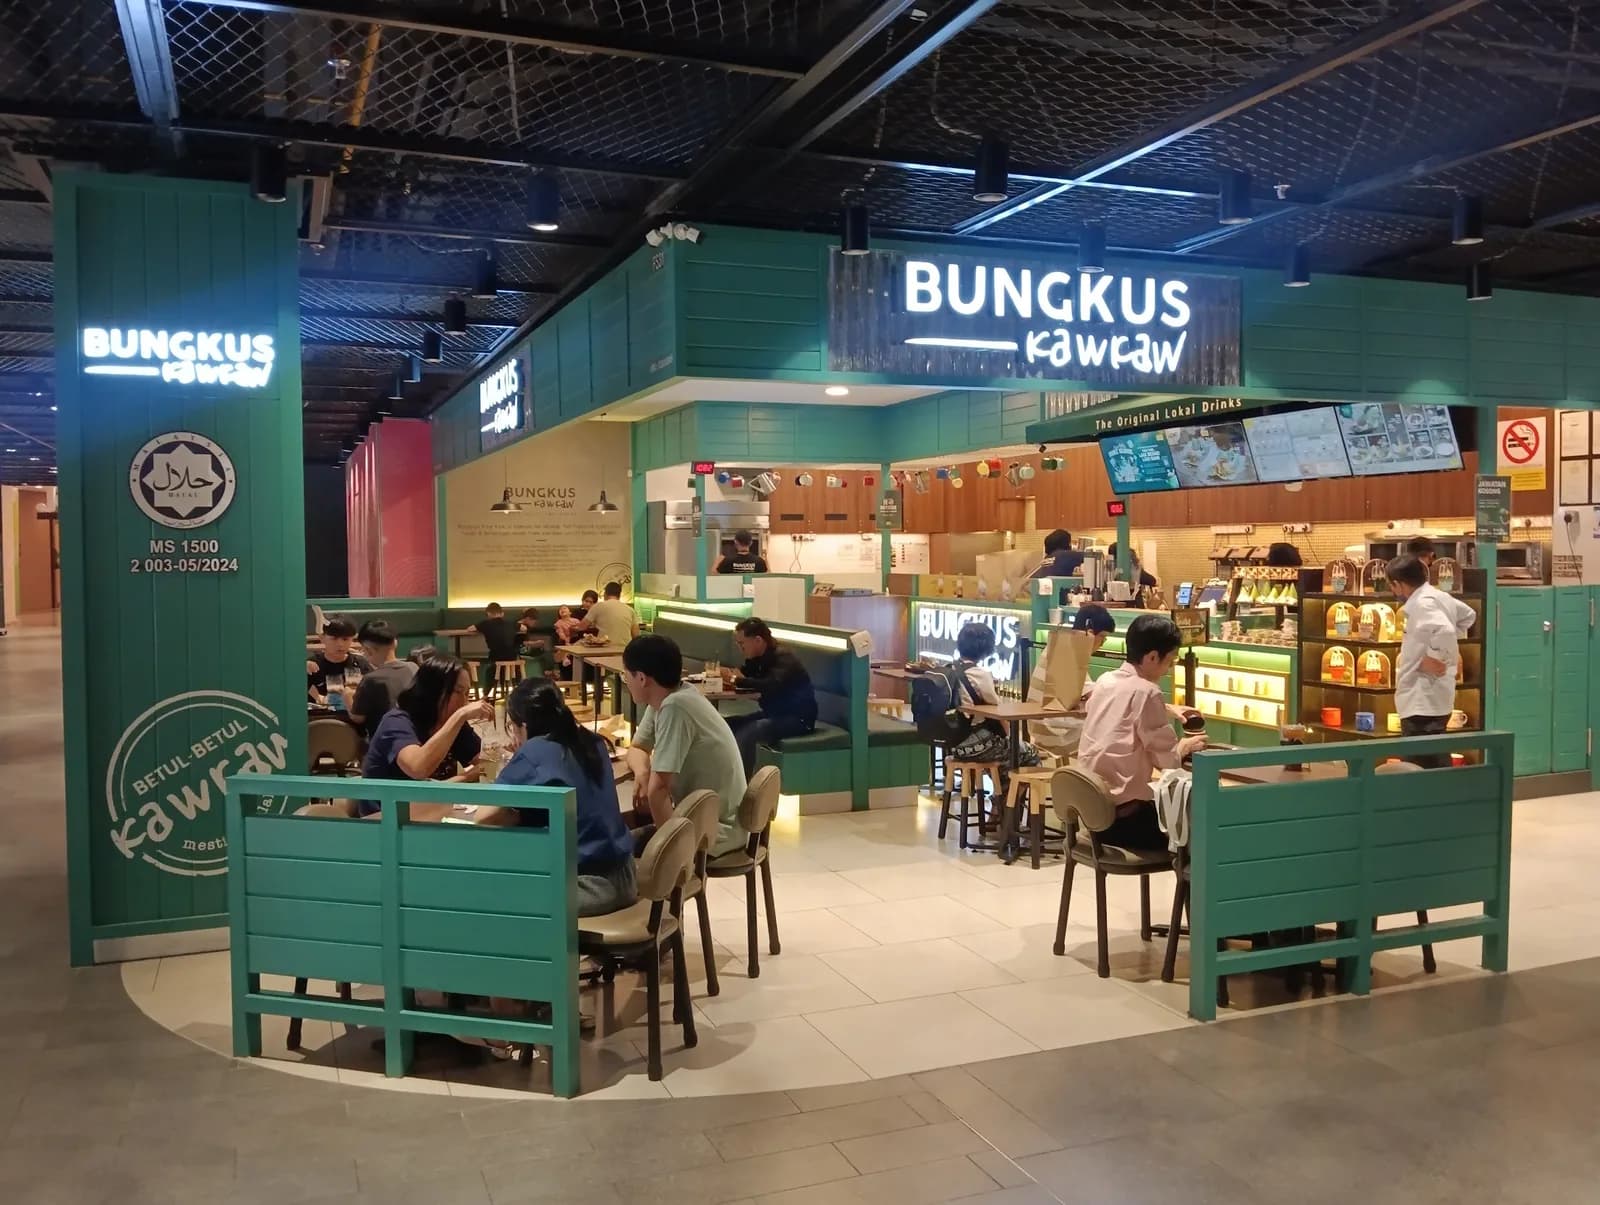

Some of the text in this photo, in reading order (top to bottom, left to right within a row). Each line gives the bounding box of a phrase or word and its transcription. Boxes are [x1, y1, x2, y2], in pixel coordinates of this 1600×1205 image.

[905, 261, 1191, 328] BUNGKUS
[83, 326, 275, 363] BUNGKUS
[1025, 328, 1188, 375] kawraw
[1095, 397, 1243, 431] The Original Lokal Drinks
[153, 461, 214, 491] حلال
[506, 487, 576, 499] BUNGKUS
[150, 540, 219, 553] MS 1500
[130, 558, 239, 573] 2 003-05/2024
[131, 719, 249, 796] BETUL-BETUL
